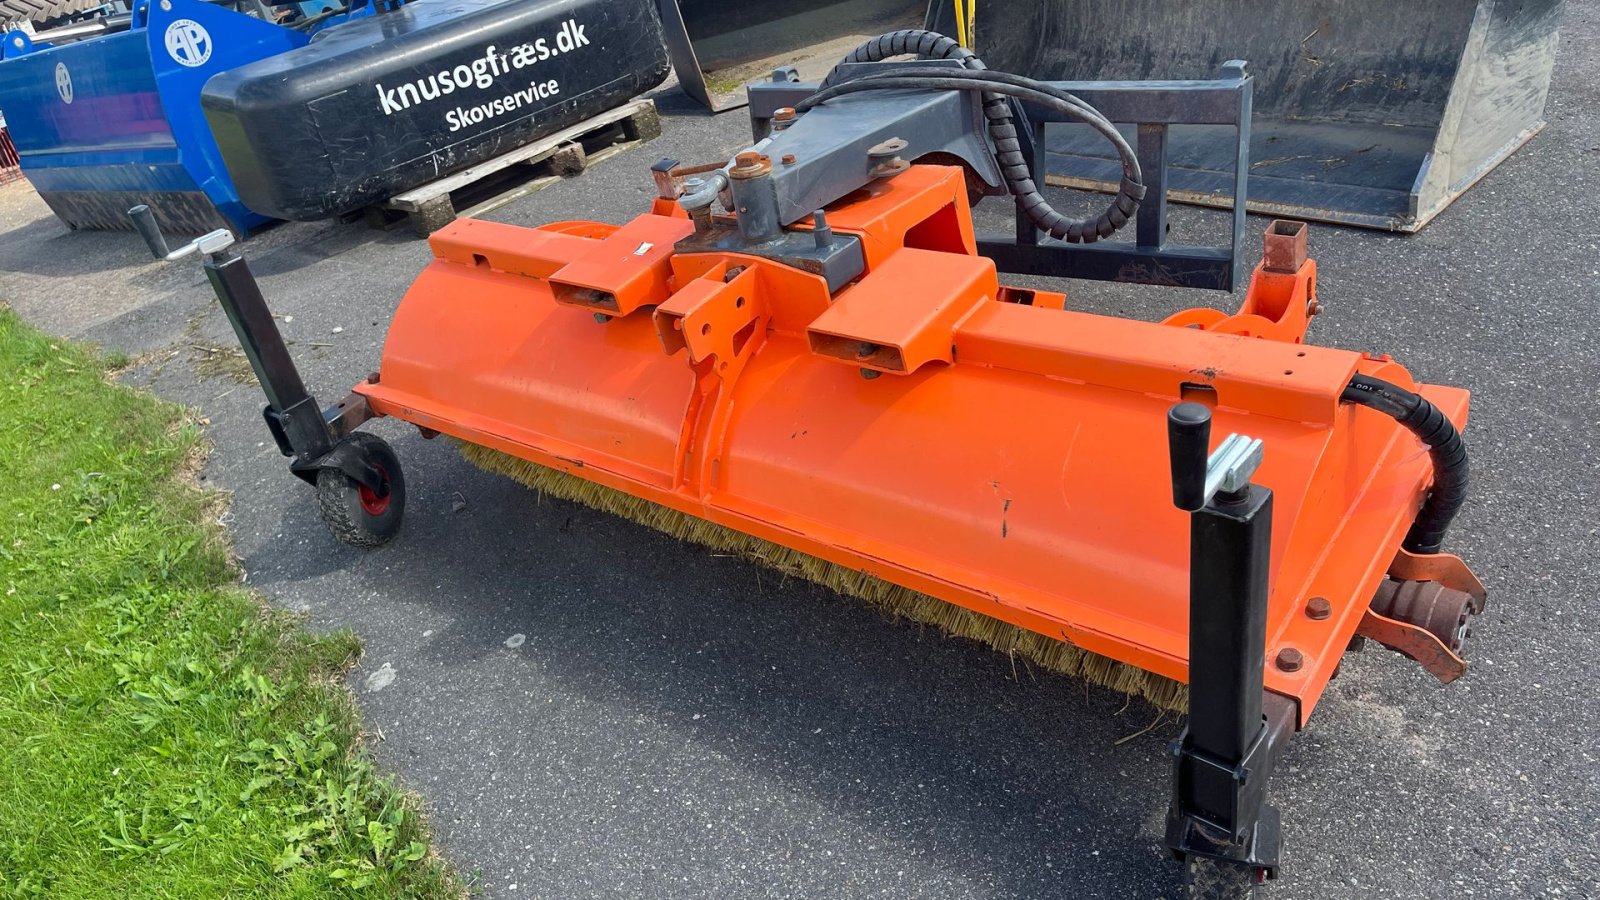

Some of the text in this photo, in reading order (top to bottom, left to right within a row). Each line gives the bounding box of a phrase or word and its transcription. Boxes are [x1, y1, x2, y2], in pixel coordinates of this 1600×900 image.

[168, 24, 206, 61] AP
[375, 18, 590, 115] knusogfræs.dk
[445, 78, 560, 132] Skovservice
